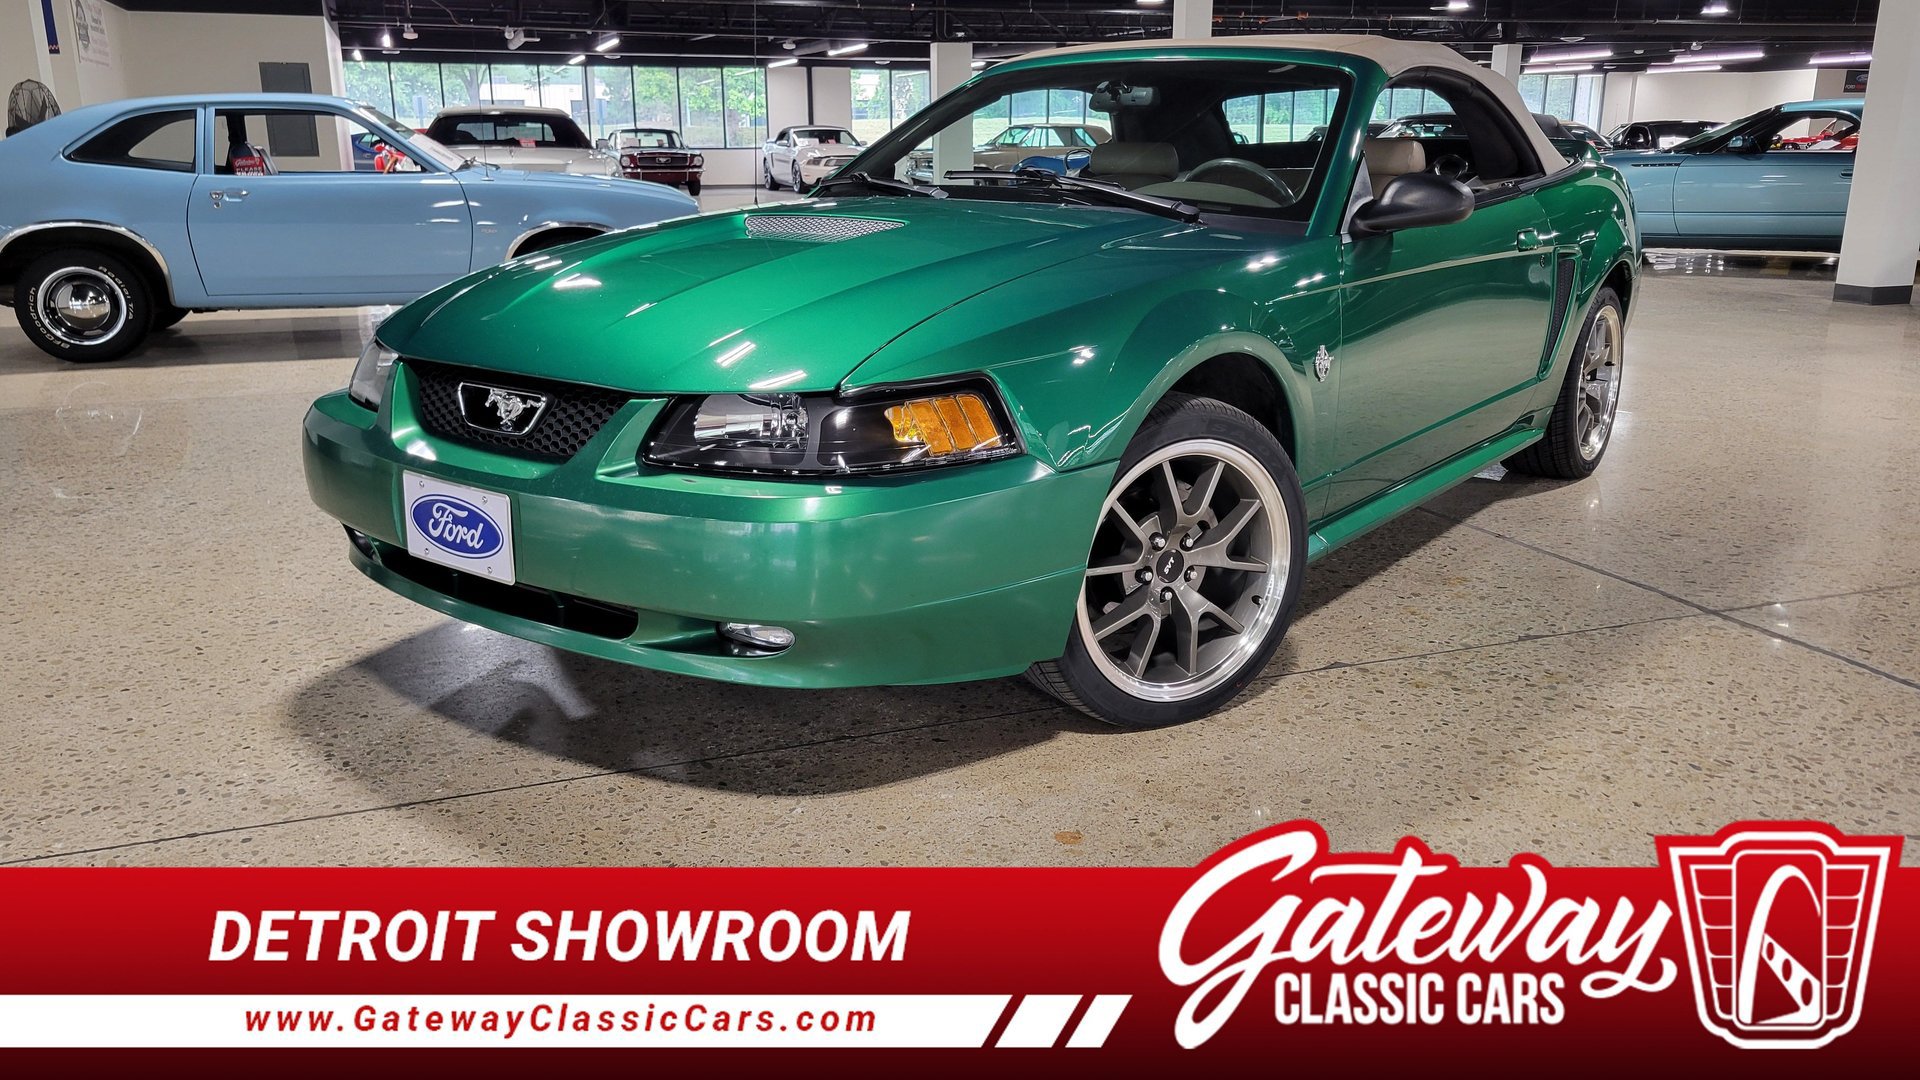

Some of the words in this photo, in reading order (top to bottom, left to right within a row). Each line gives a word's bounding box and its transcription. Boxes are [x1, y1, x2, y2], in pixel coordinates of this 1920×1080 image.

[98, 266, 132, 299] Radial
[28, 287, 71, 350] BFGoodrich
[428, 502, 484, 549] Ford
[1163, 556, 1175, 575] SVT
